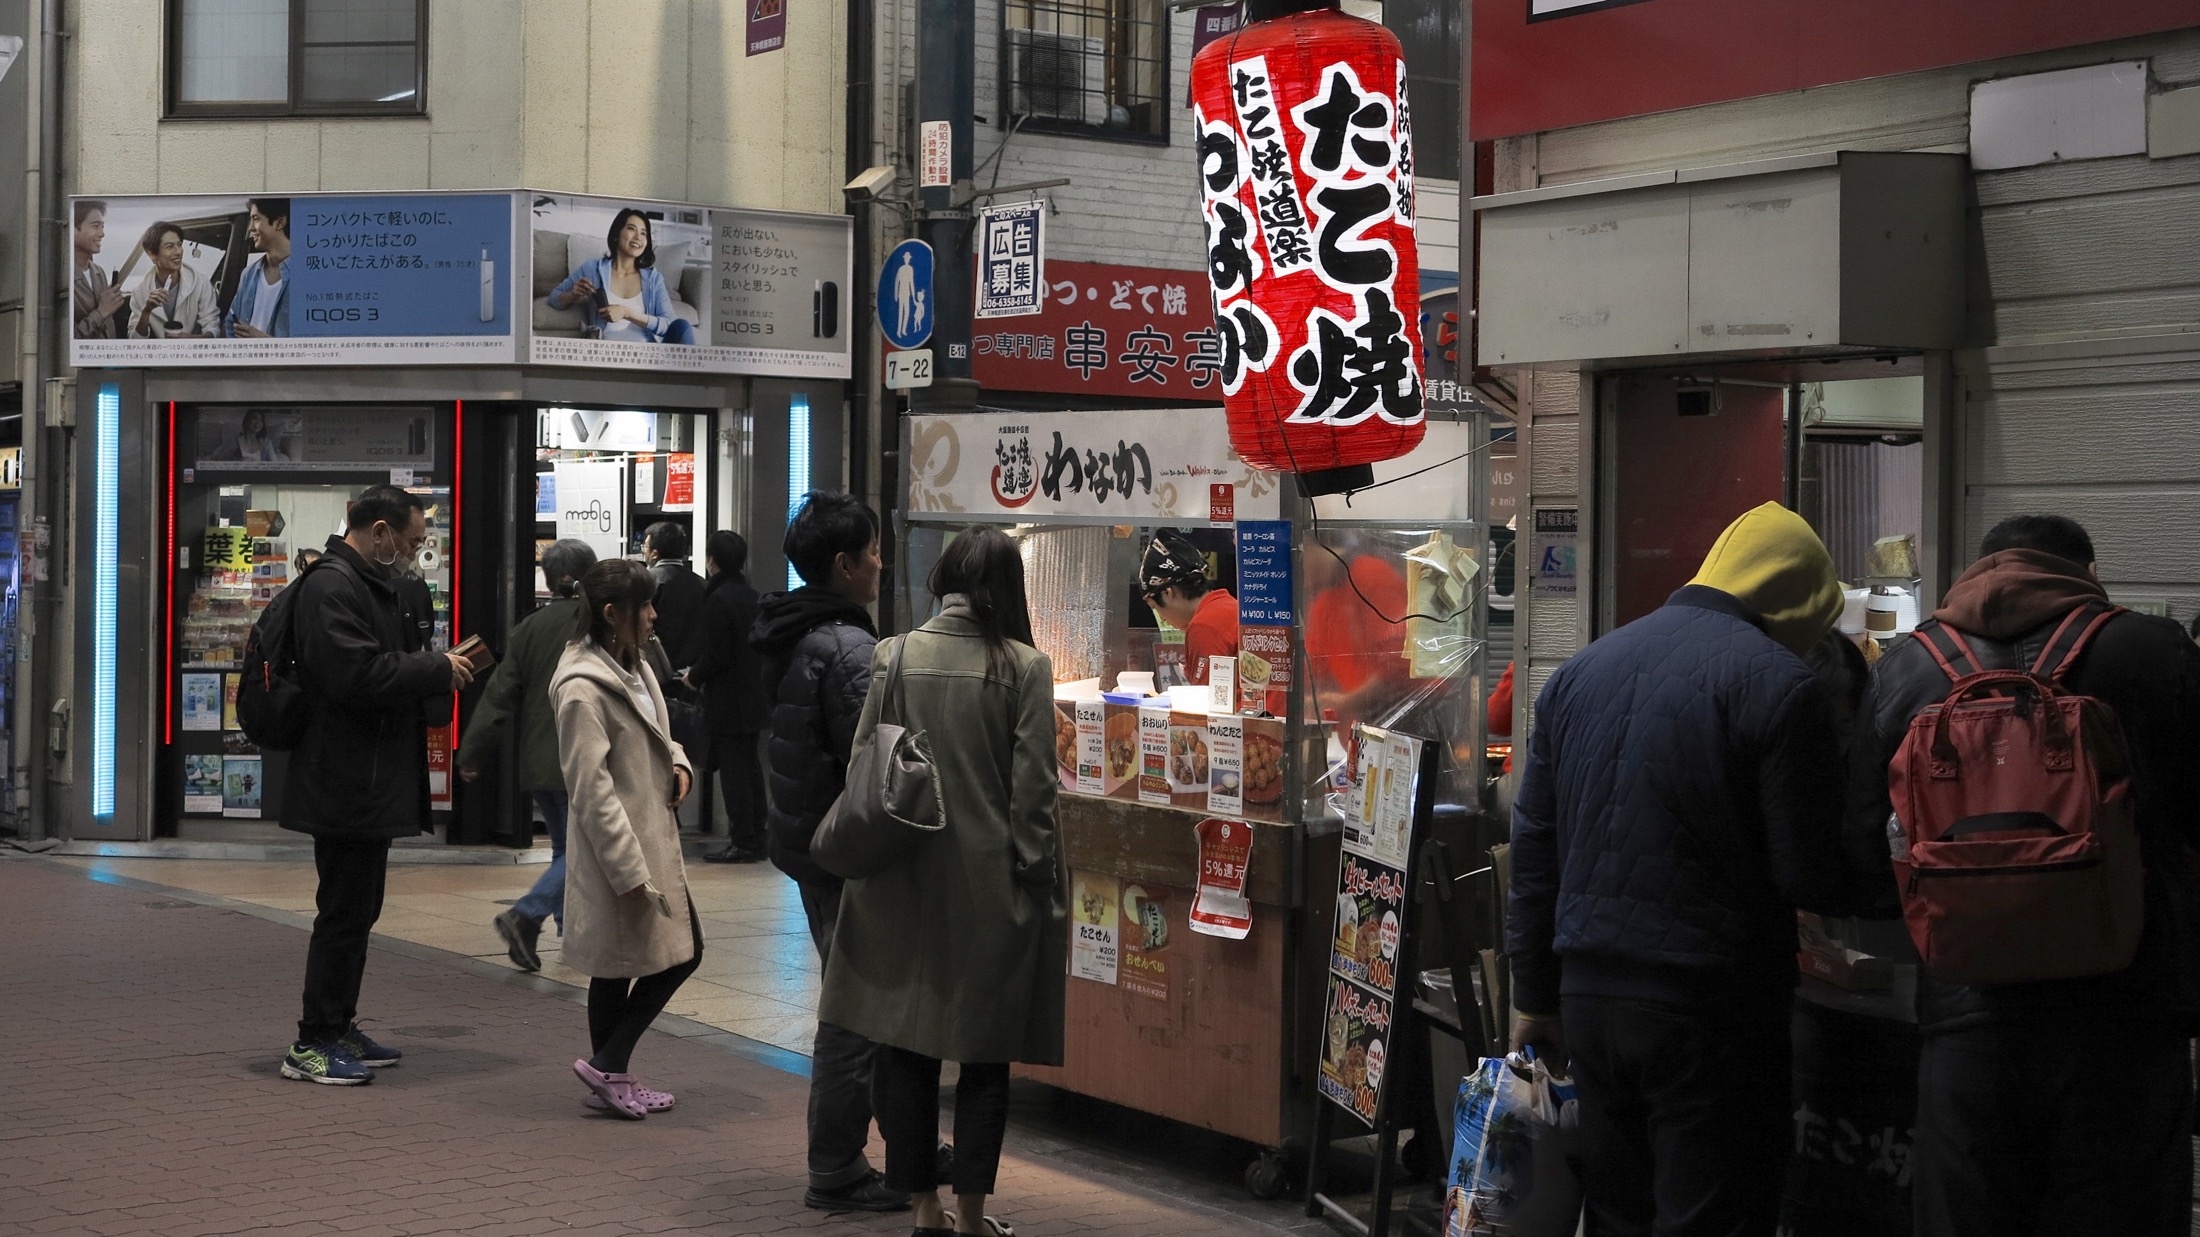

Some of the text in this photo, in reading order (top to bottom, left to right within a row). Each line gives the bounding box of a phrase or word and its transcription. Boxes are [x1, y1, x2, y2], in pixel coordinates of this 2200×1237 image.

[928, 130, 937, 183] 24時間作動中
[939, 123, 948, 183] 防犯カメラ設置
[307, 211, 453, 226] コンパクトで軽いのに、
[306, 234, 417, 248] しっかりたばこの
[721, 226, 779, 242] 灰が出ない。
[993, 223, 1032, 255] 広告
[722, 244, 798, 260] においも少ない。
[1294, 71, 1420, 418] たこ焼
[306, 255, 430, 270] 吸いごたえがある。
[722, 262, 798, 277] スタイリッシュで
[721, 278, 776, 293] 良いと思う。
[991, 262, 1031, 294] 募集
[1043, 279, 1187, 316] つ・どて焼
[306, 308, 379, 324] IQOS 3
[720, 321, 774, 335] IQOS 3
[971, 320, 1222, 389] つ専門店 串安亭
[889, 358, 929, 380] 7-22
[1041, 430, 1152, 503] わなか
[1241, 609, 1291, 620] M ¥100 L ¥150
[1077, 709, 1103, 722] たこせん
[1142, 716, 1168, 730] おおいり
[1209, 724, 1242, 739] わんこだこ
[1206, 842, 1245, 854] キャッシュレスで
[1205, 860, 1244, 880] 5%還元
[1344, 857, 1403, 906] 生ビールセット
[1080, 926, 1111, 943] たこせん
[1099, 946, 1116, 956] ¥200
